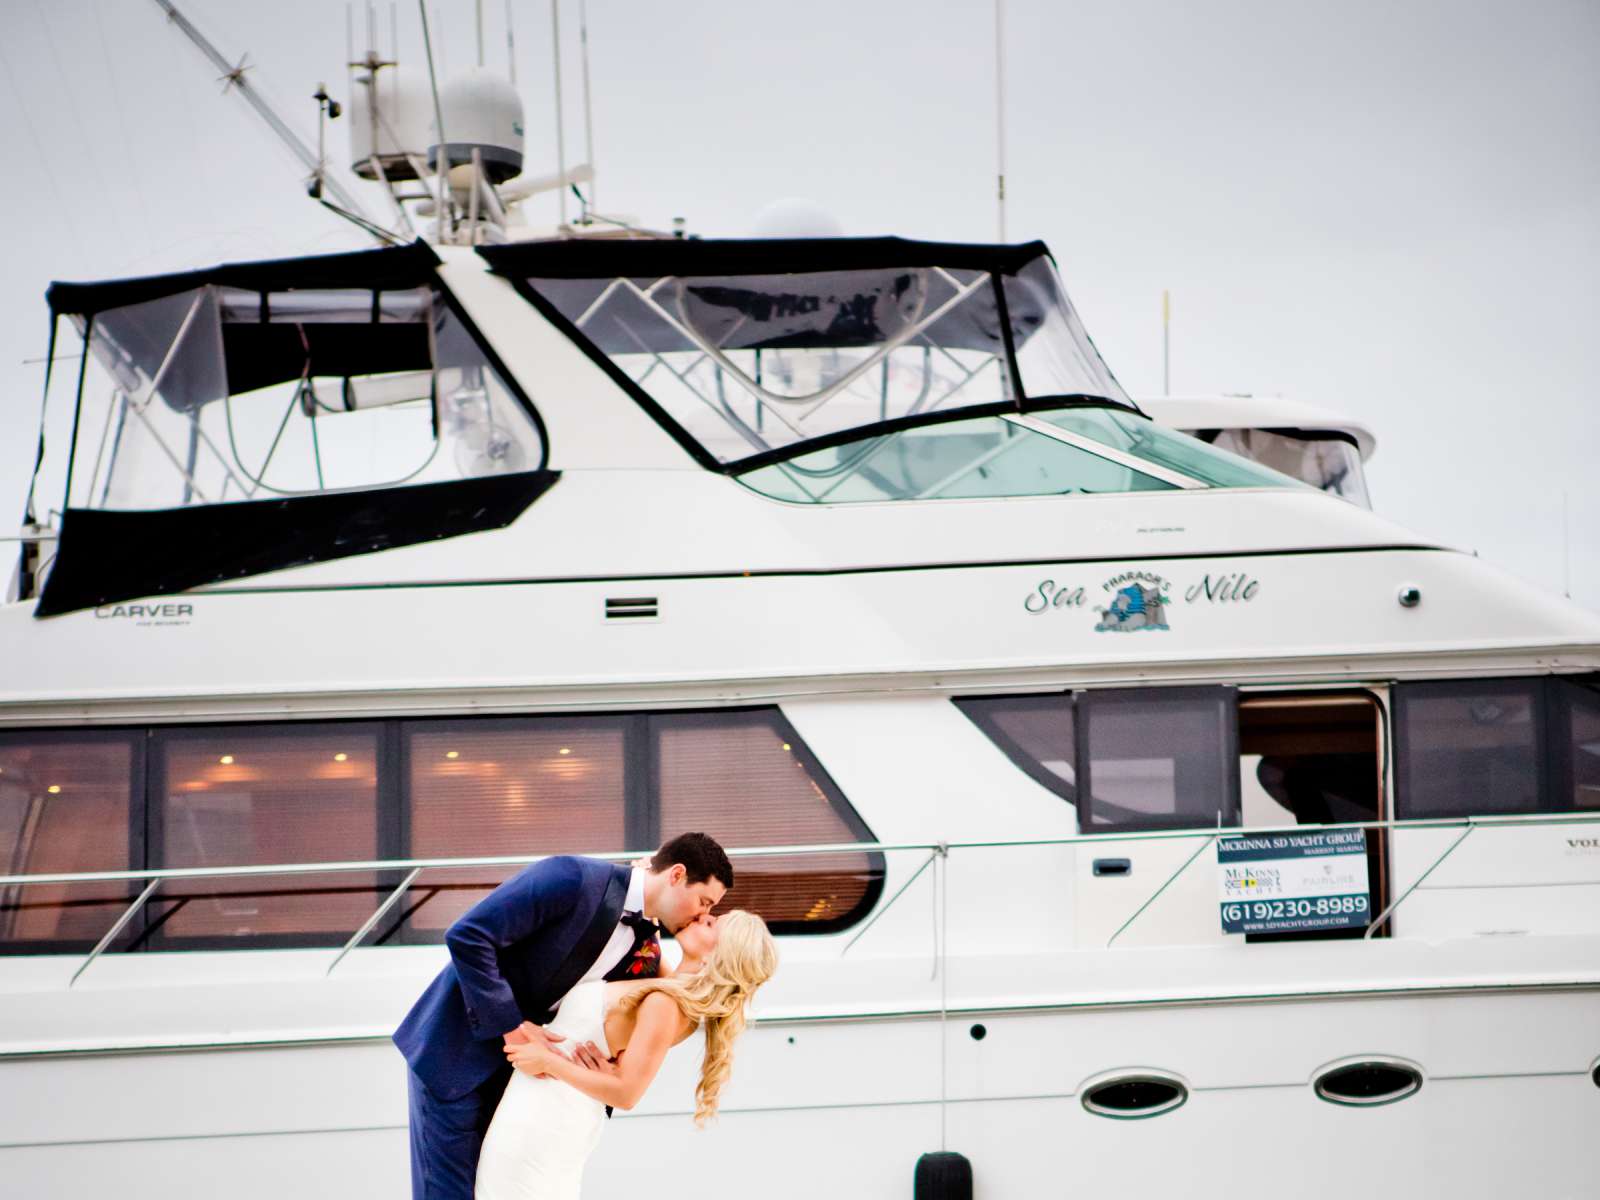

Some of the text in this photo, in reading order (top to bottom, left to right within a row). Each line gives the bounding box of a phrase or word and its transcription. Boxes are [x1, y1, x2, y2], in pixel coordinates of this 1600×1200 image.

[1024, 573, 1260, 614] Sea Nile
[95, 604, 193, 619] CARVER
[1218, 831, 1363, 851] MCKINNA SD YACHT GROUP
[1222, 896, 1368, 923] (619)230-8989
